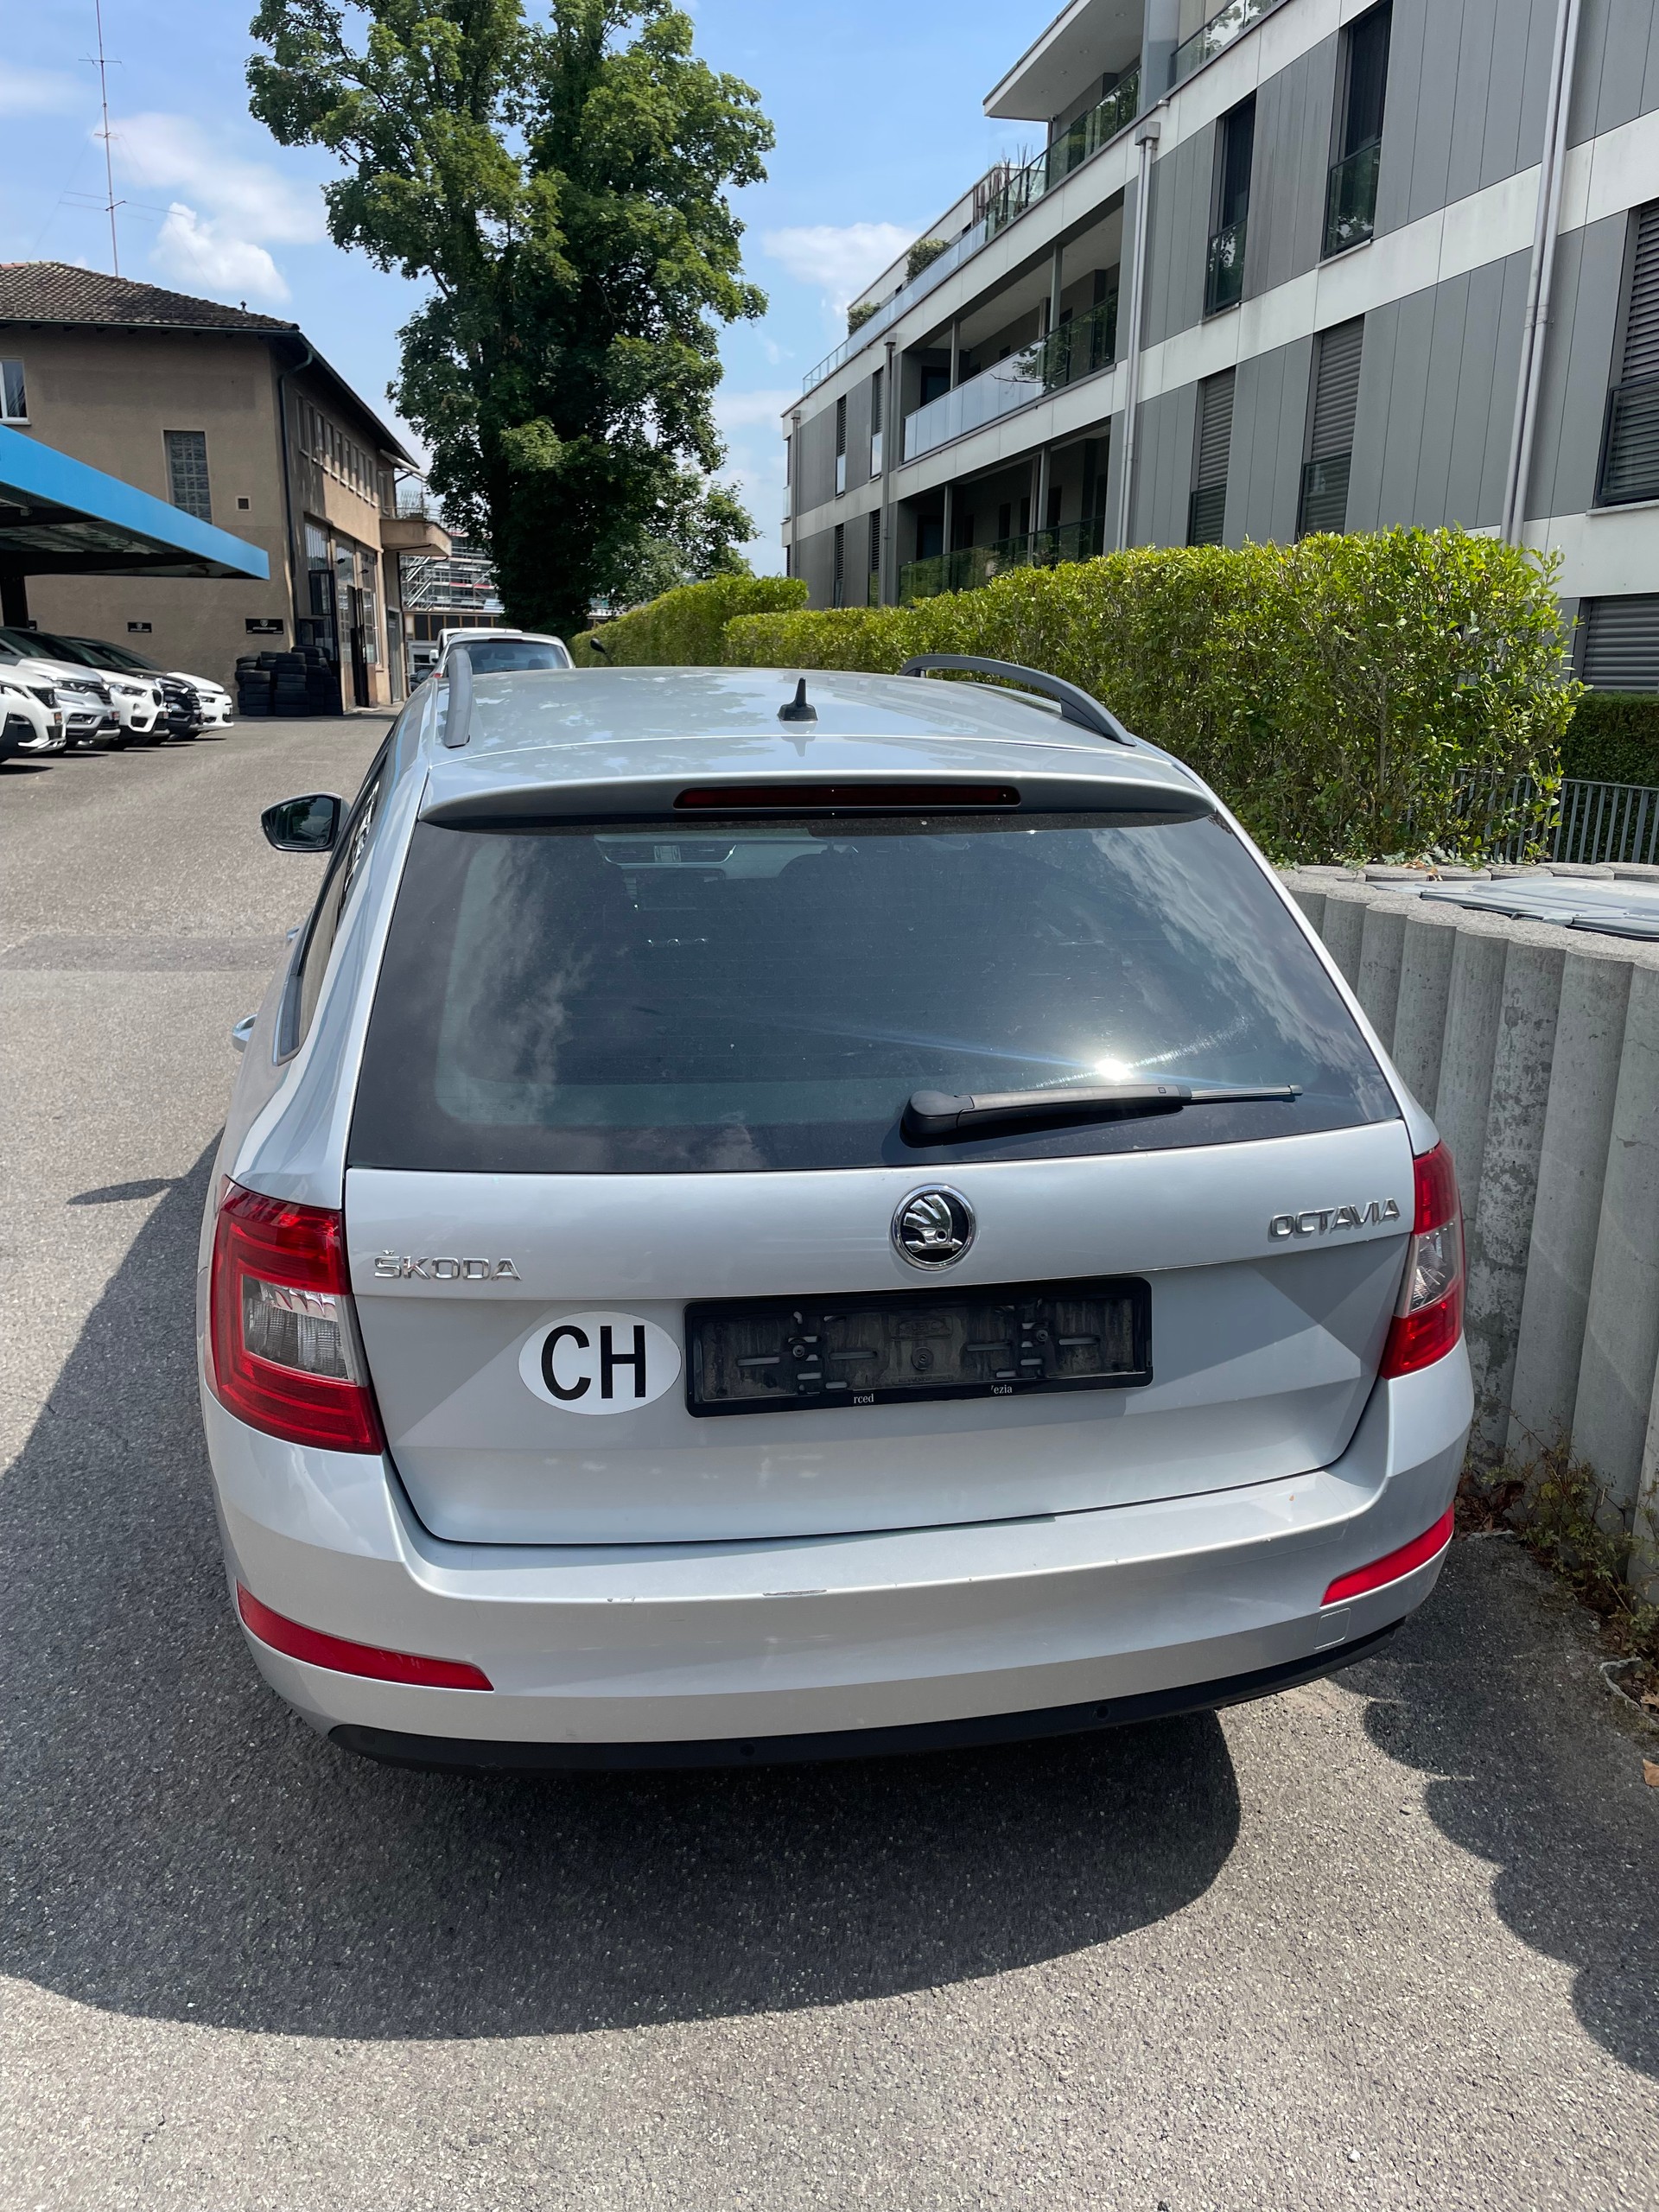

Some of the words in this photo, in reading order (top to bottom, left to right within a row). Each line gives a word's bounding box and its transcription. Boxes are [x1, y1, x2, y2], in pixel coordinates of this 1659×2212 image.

[1270, 1198, 1401, 1237] OCTAVIA
[374, 1249, 522, 1281] ŠKODA
[541, 1325, 646, 1401] CH
